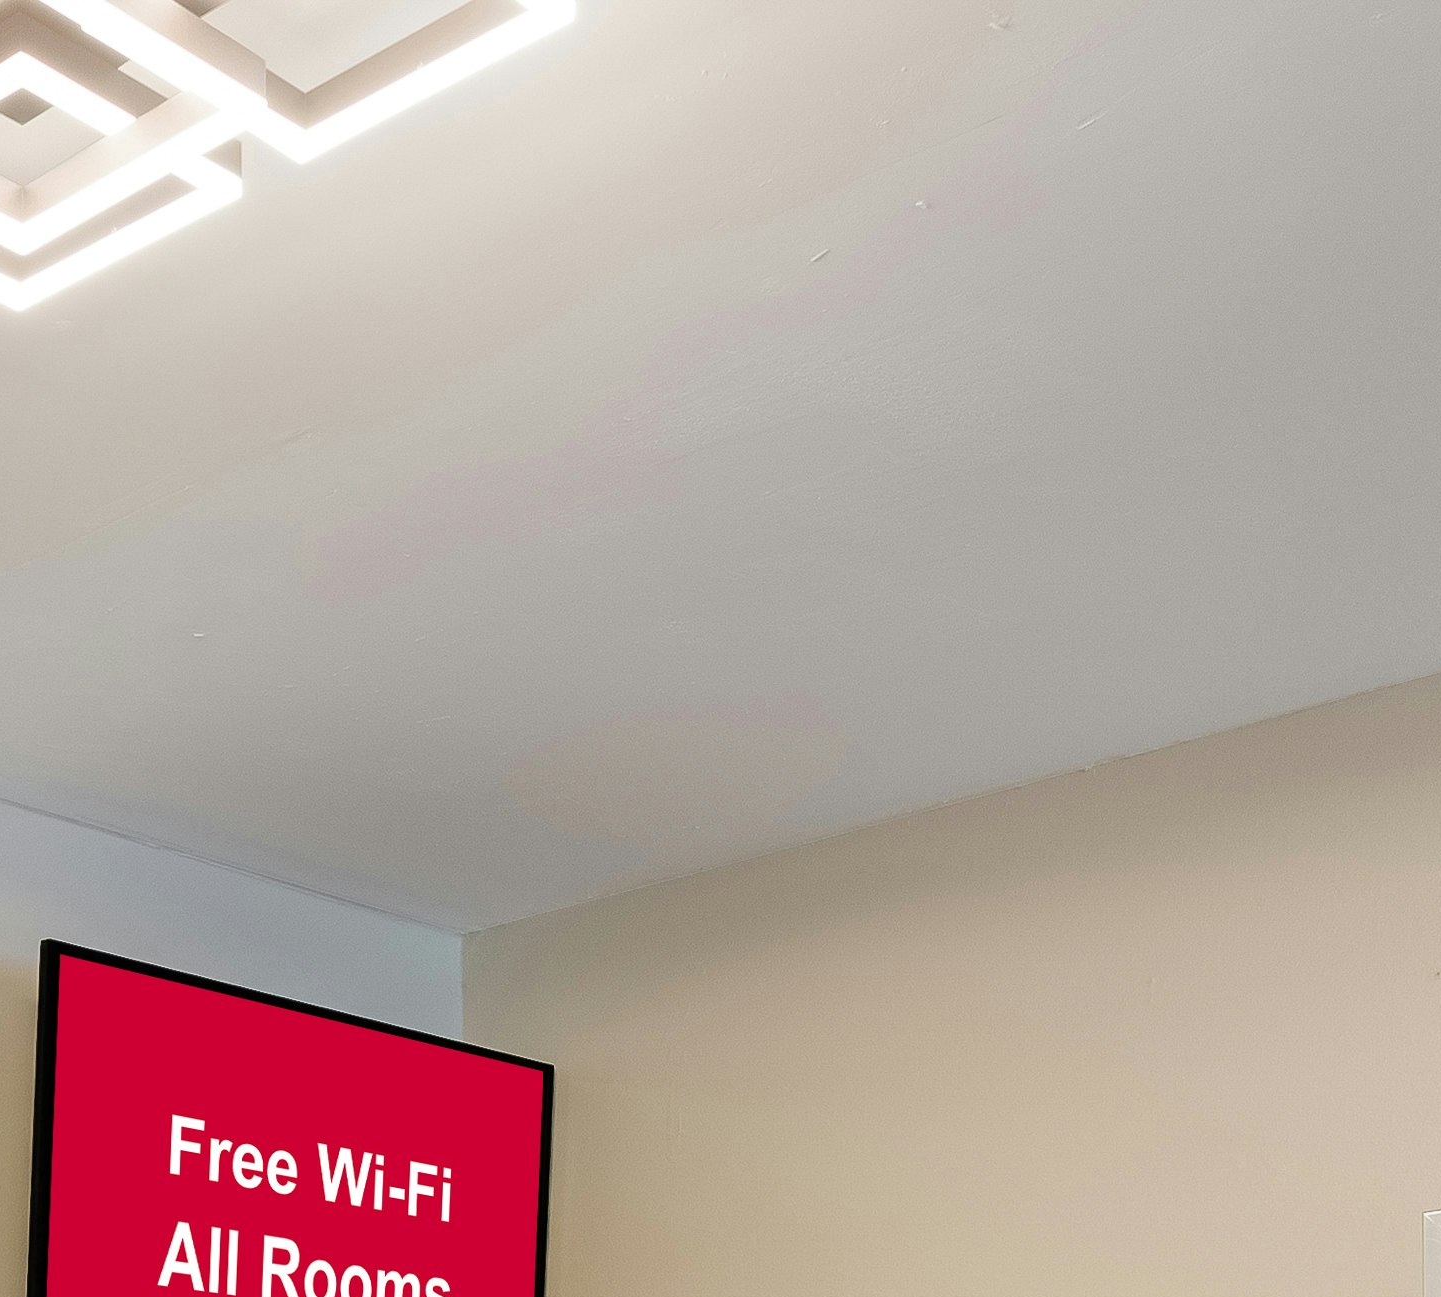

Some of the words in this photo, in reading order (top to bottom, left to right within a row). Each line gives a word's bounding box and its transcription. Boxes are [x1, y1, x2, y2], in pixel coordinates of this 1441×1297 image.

[169, 1114, 298, 1195] Free
[317, 1142, 452, 1222] Wi-Fi
[157, 1221, 239, 1296] All
